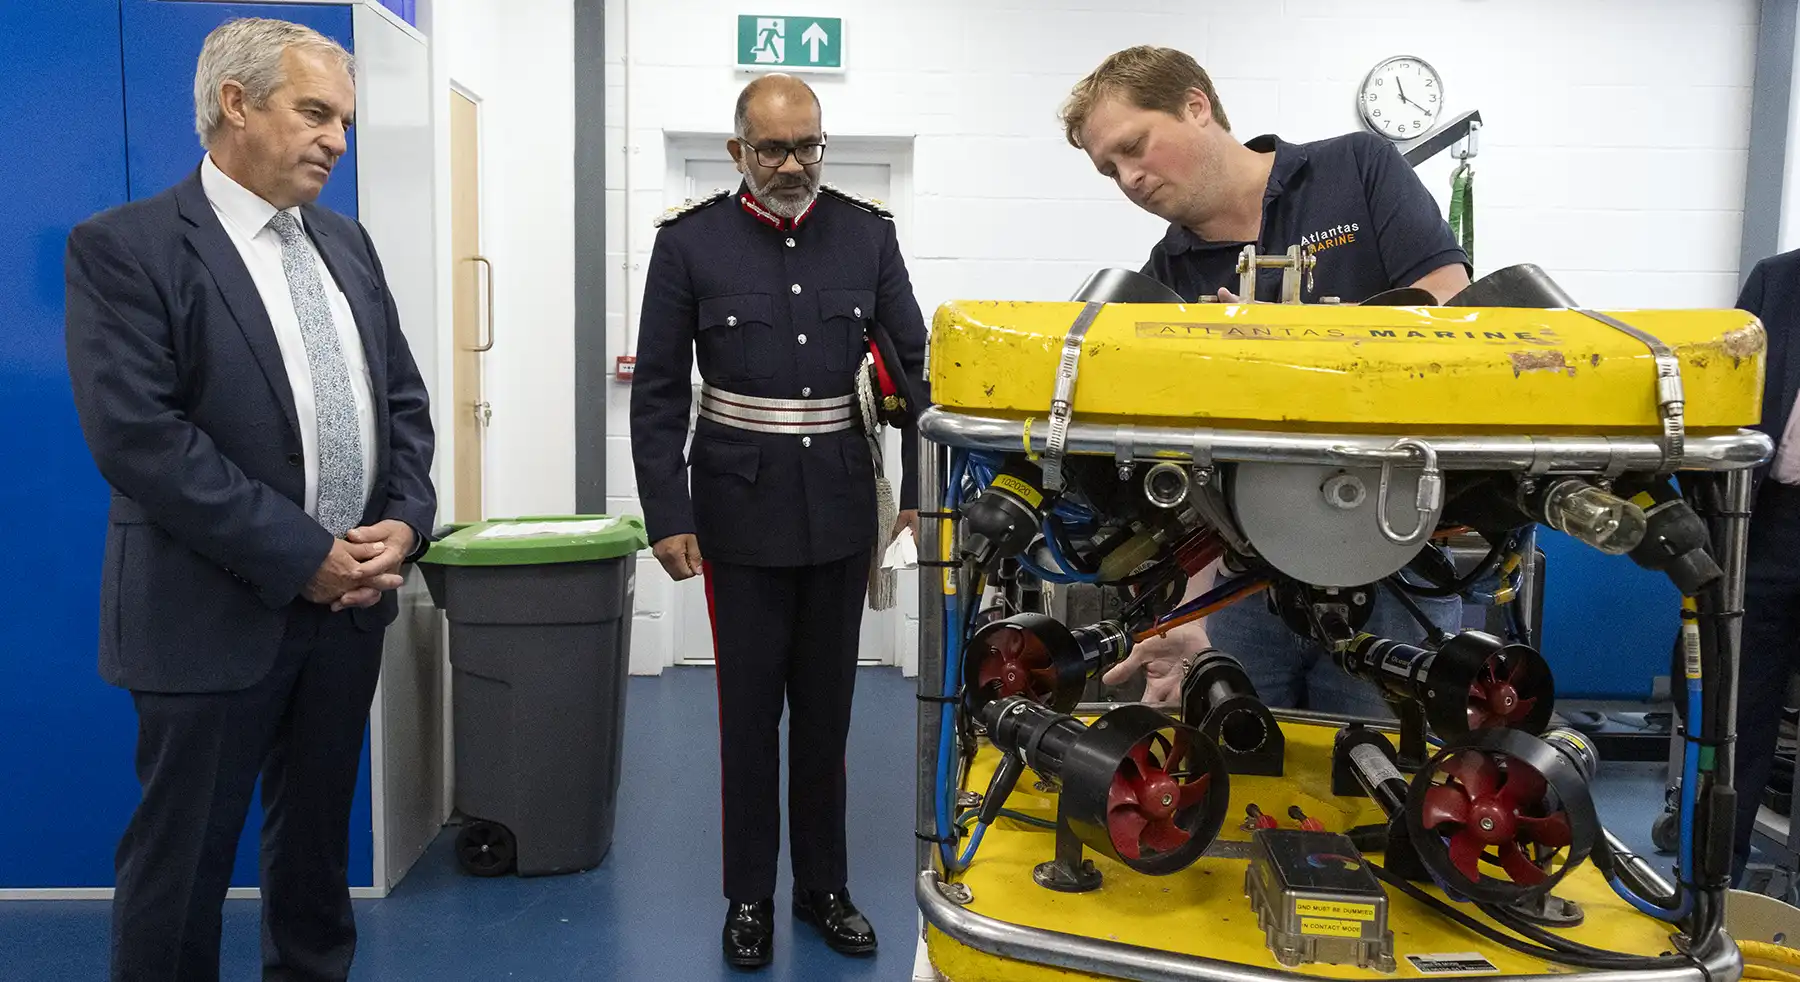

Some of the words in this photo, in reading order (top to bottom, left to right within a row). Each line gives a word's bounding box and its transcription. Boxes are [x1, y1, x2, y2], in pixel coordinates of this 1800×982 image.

[1375, 78, 1383, 87] 10
[1424, 79, 1432, 87] 2
[1370, 94, 1378, 102] 9
[1428, 94, 1436, 102] 3
[1372, 109, 1381, 117] 8
[1384, 120, 1390, 128] 7
[1398, 124, 1406, 132] 6
[1413, 120, 1421, 128] 5
[1300, 223, 1359, 247] Atlantas
[1159, 325, 1346, 338] ATLANTAS
[1368, 329, 1538, 341] MARINE
[1001, 478, 1030, 496] 102020
[1343, 908, 1374, 916] DUMMIED
